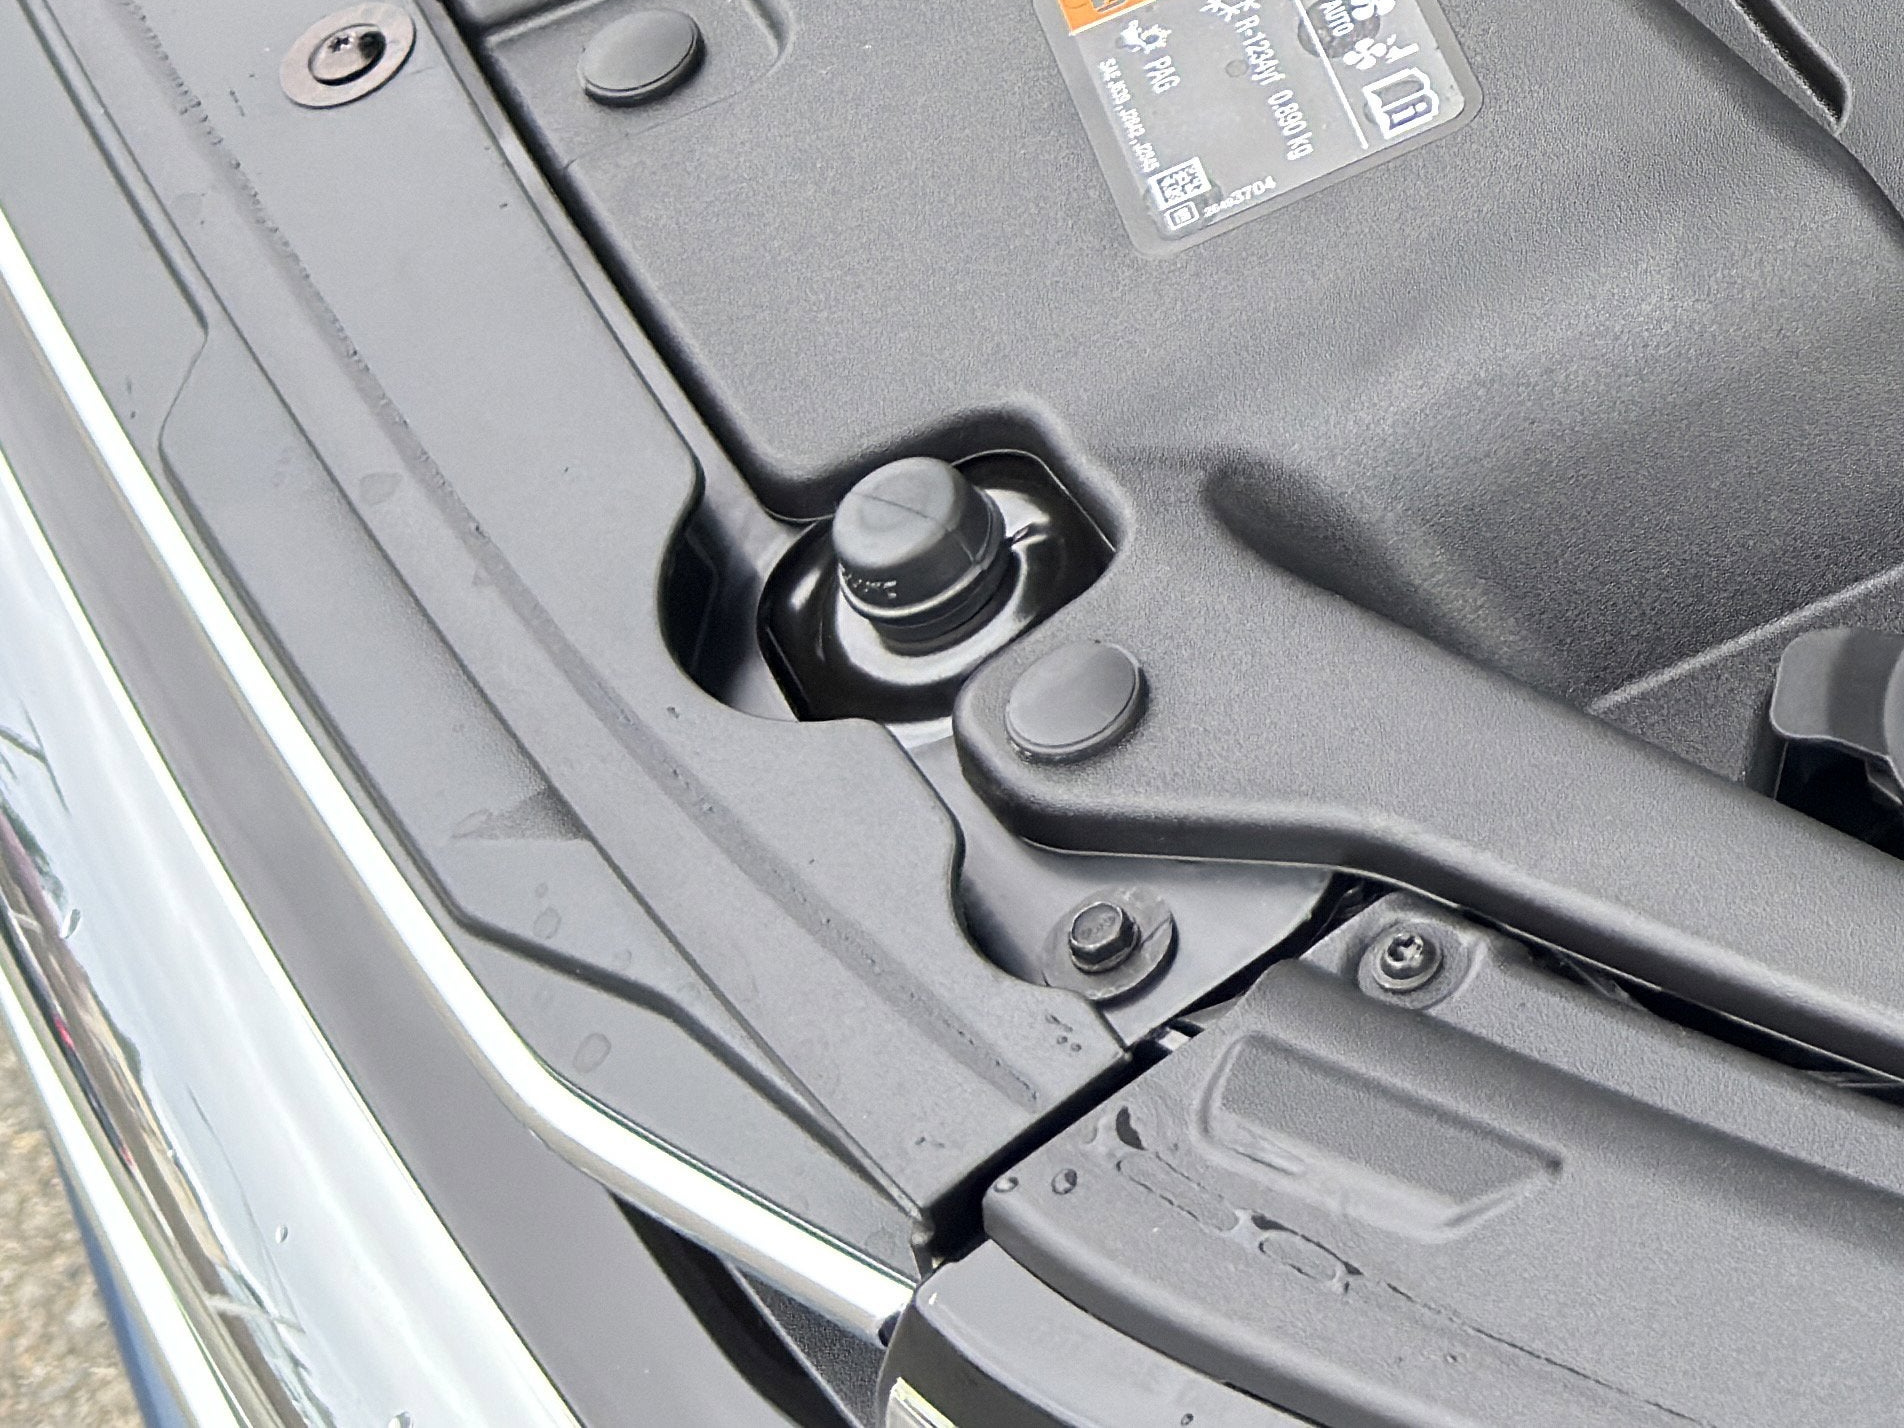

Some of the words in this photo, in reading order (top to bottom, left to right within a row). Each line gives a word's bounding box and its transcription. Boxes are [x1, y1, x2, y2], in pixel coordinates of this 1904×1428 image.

[1318, 0, 1354, 37] AUTO
[1234, 15, 1286, 86] R-1234yf
[1142, 55, 1181, 95] PAG
[1267, 89, 1307, 136] 0.890
[1286, 132, 1314, 160] kg
